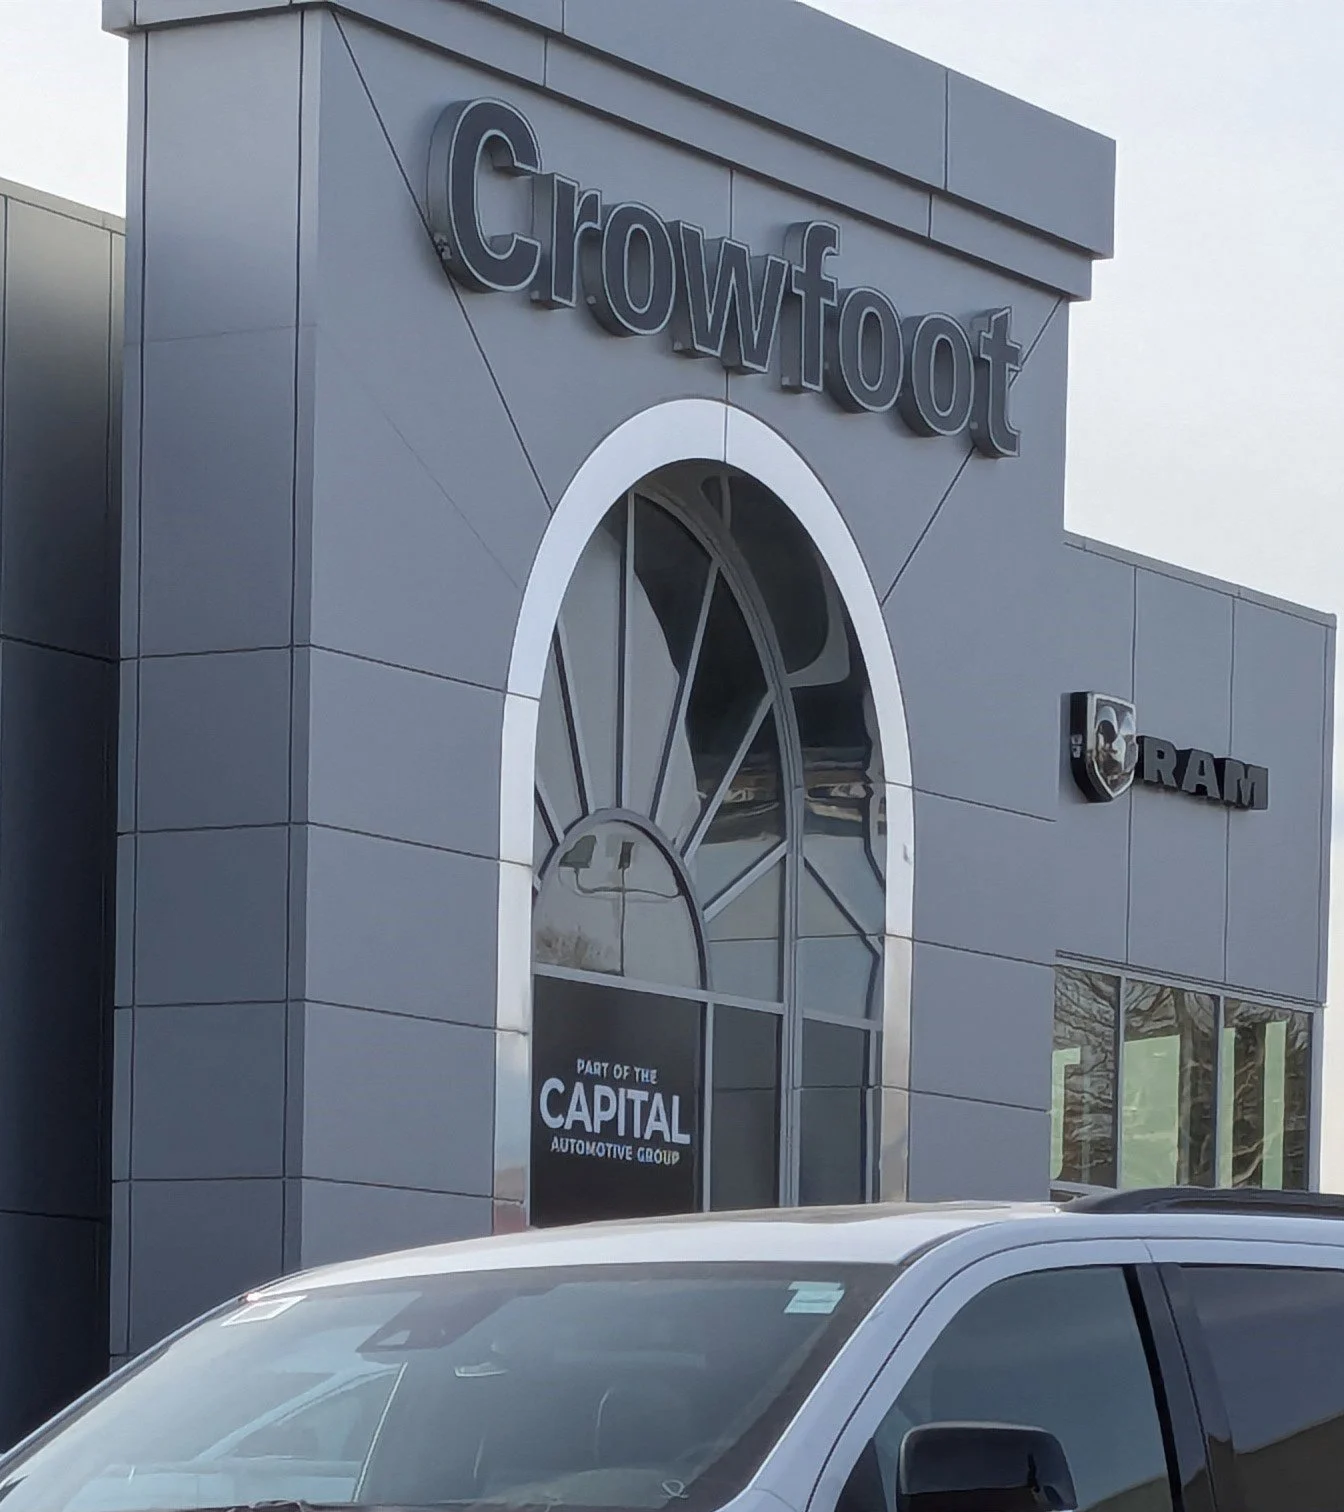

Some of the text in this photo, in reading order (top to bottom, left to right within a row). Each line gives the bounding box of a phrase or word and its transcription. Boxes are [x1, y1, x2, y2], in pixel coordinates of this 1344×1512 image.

[428, 96, 1022, 457] Crowfoot
[1137, 735, 1269, 810] RAM
[576, 1058, 658, 1084] PART OF THE
[539, 1077, 691, 1144] CAPITAL
[550, 1136, 680, 1165] AUTOMOTIVE GROUP
